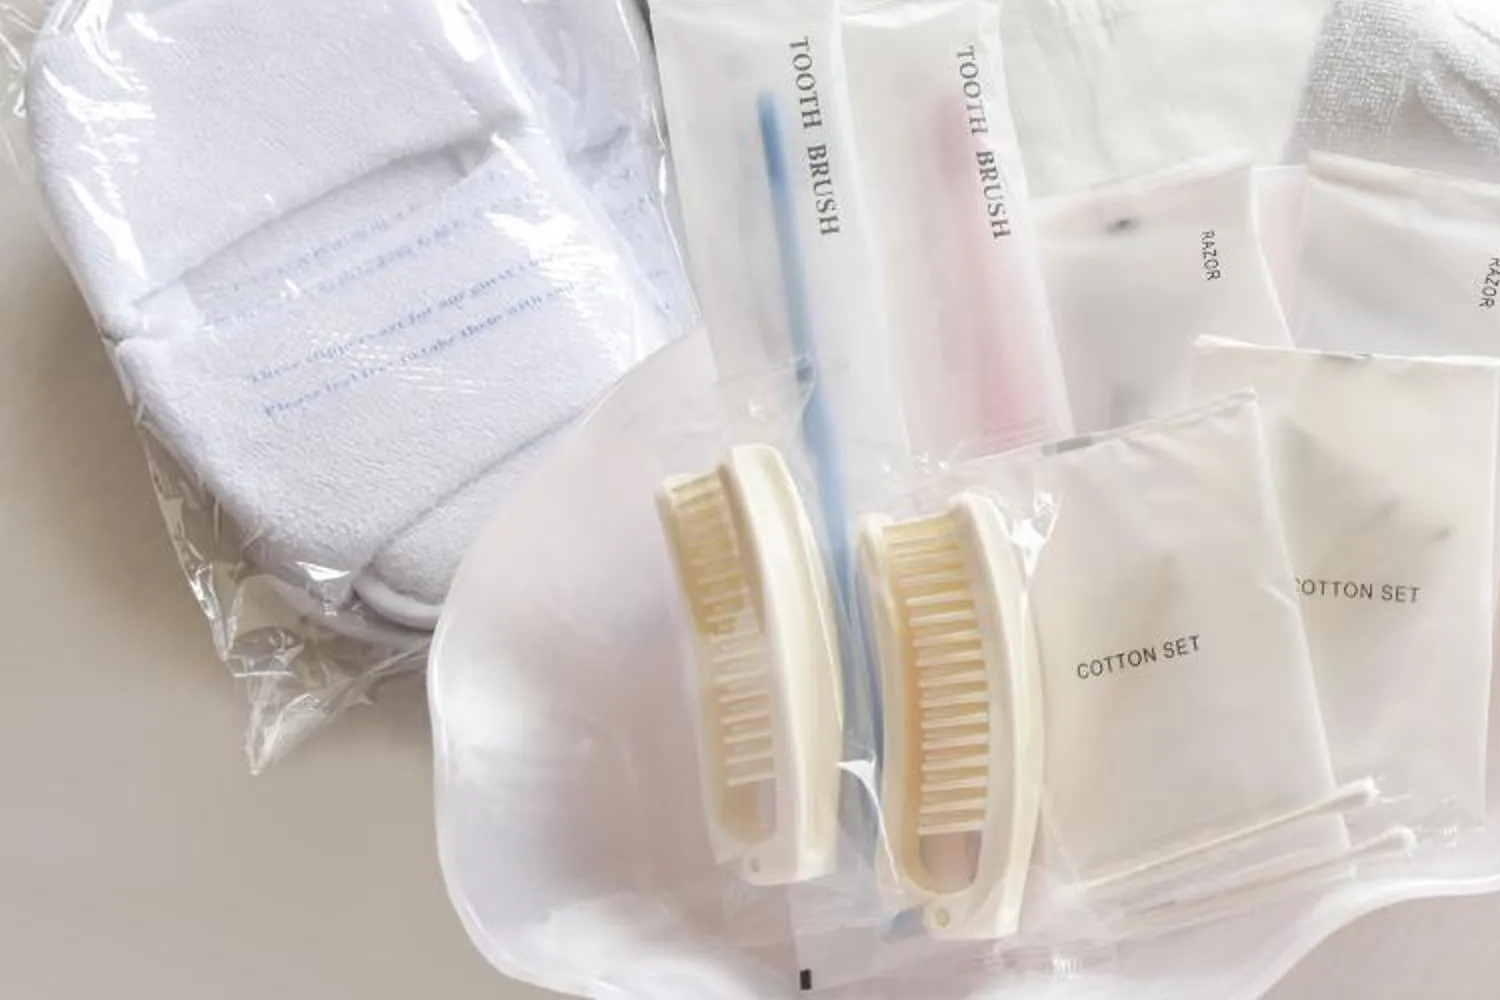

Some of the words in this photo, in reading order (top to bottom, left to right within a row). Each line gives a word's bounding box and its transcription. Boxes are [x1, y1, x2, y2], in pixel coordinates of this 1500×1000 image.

[789, 36, 823, 129] TOOTH
[807, 144, 841, 235] BRUSH
[956, 45, 988, 136] TOOTH
[975, 150, 1011, 239] BRUSH
[1201, 229, 1221, 281] RAZOR
[1381, 584, 1421, 603] SET
[1076, 647, 1158, 680] COTTON
[1163, 634, 1200, 660] SET
